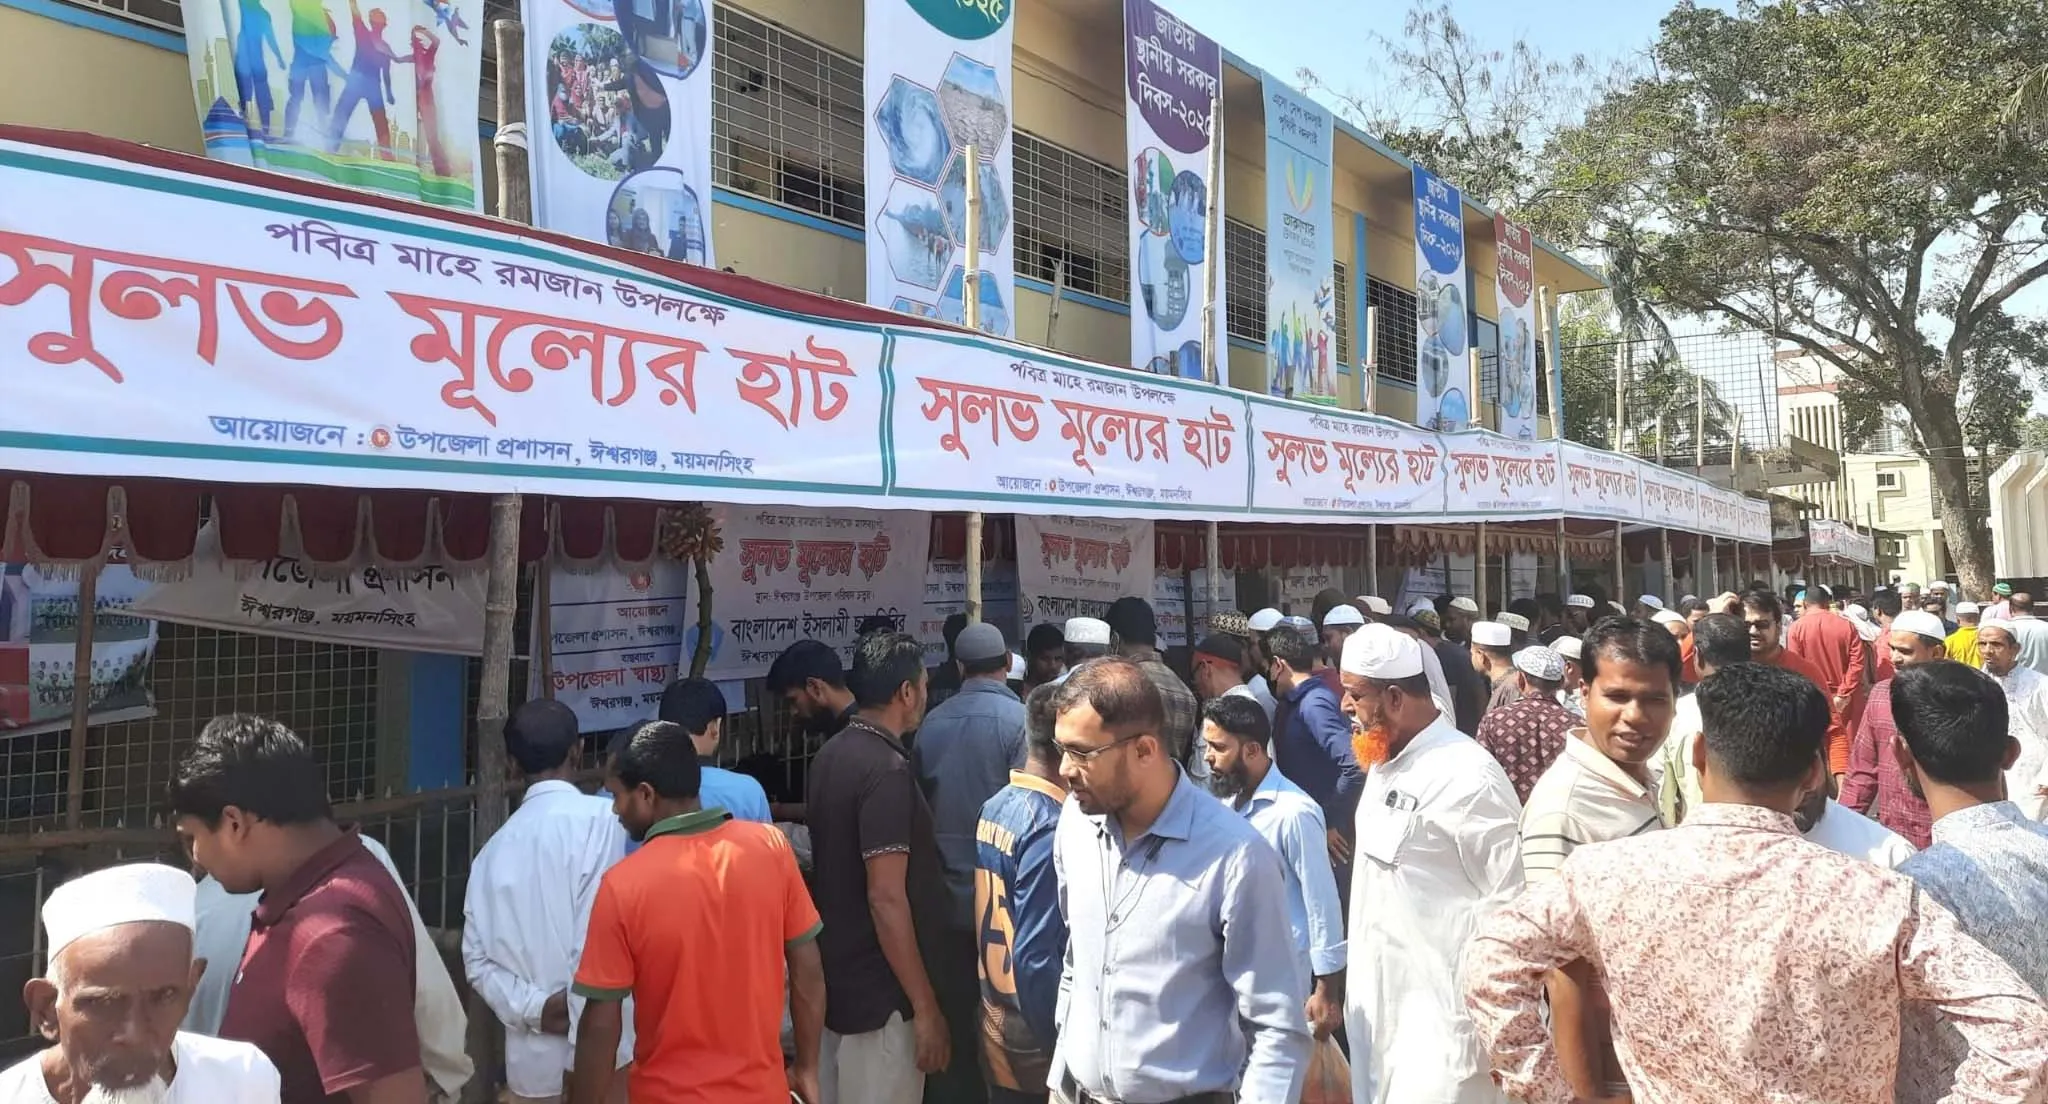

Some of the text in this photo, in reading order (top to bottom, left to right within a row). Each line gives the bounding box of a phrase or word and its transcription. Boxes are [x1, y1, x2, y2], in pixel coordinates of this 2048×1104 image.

[1154, 9, 1197, 55] জাতীয়
[1134, 35, 1218, 98] স্থানীয় সরকার
[265, 220, 728, 327] পবিত্র মাহে রমজান উপলক্ষে
[0, 230, 857, 431] সুলভ মূল্যের হাট
[1009, 361, 1177, 405] পবিত্র মাহে রমজান উপলক্ষে
[208, 415, 348, 447] আয়োজনে
[395, 424, 491, 456] উপজেলা
[672, 449, 755, 474] ময়মনসিংহ
[916, 376, 1236, 476] সুলভ মূল্যের হাট
[996, 475, 1042, 492] আয়োজনে
[1058, 478, 1091, 495] উপজেলা
[1262, 431, 1439, 495] সুলভ মূল্যের হাট
[1450, 452, 1556, 498] সুলভ মূল্যের হাট
[1567, 463, 1592, 496] সুলভ
[1593, 467, 1623, 504] মূল্যের
[739, 532, 891, 588] সুলভ মূল্যের হাট
[1040, 533, 1073, 570] সুলভ
[1074, 537, 1109, 575] মূল্যের
[332, 608, 416, 628] ময়মনসিংহ
[616, 605, 669, 619] আয়োজনে
[730, 614, 798, 644] বাংলাদেশ
[801, 608, 850, 641] ইসলামী
[1037, 596, 1078, 617] বাংলাদেশ
[552, 667, 627, 691] উপজেলা
[630, 664, 667, 683] স্বাস্থ্য
